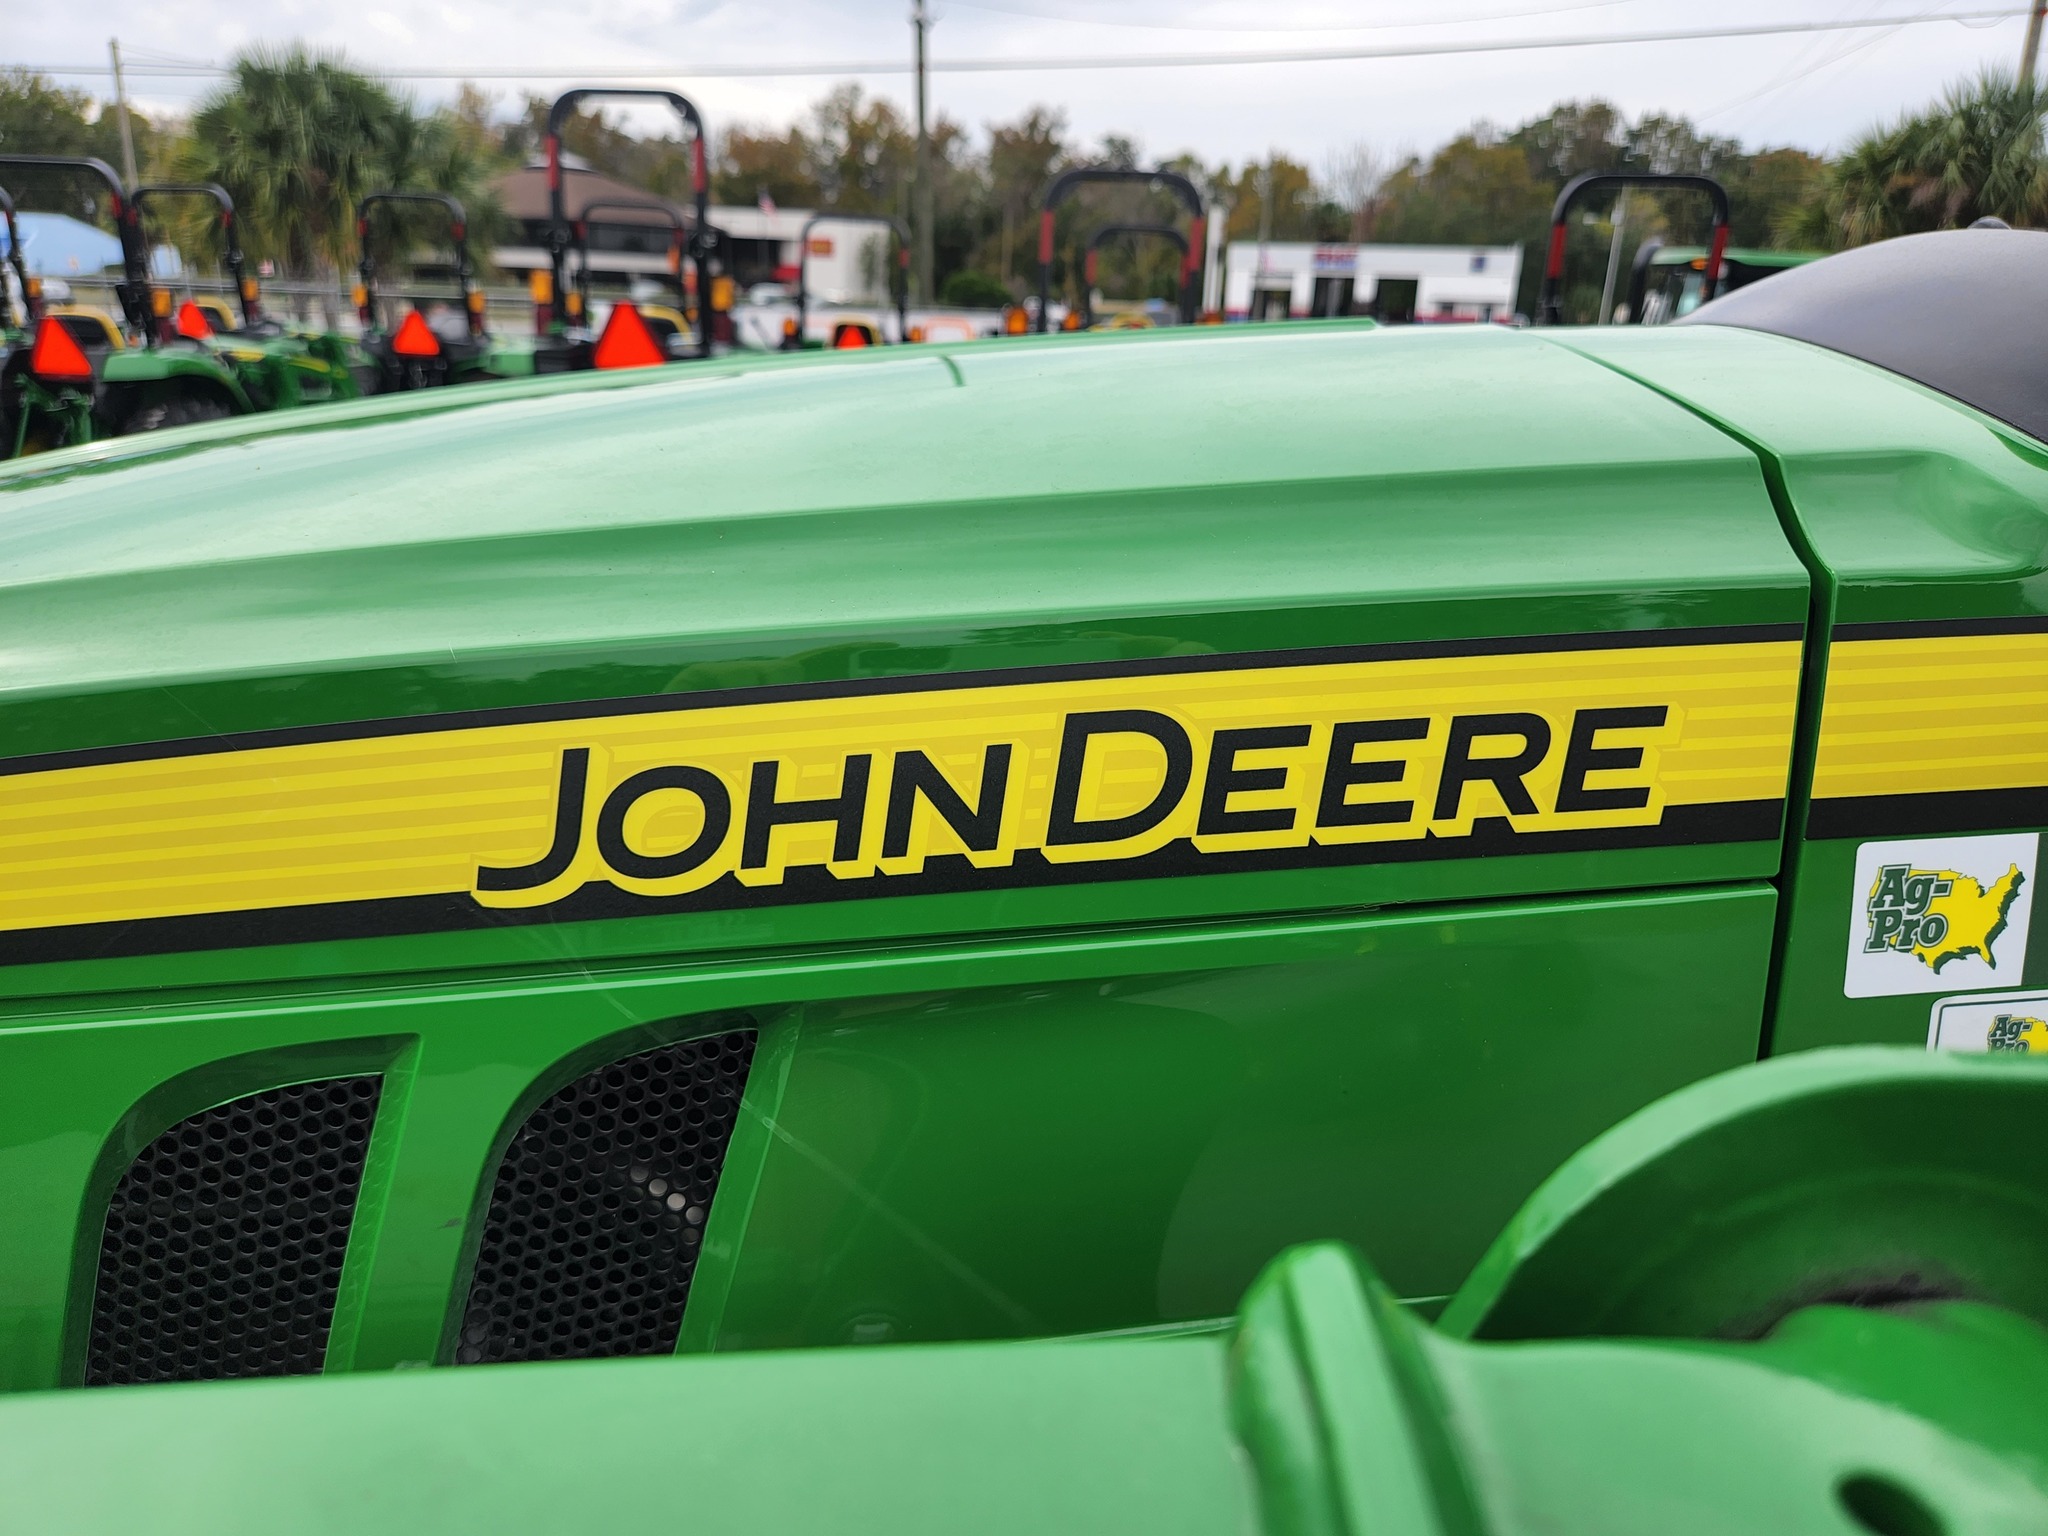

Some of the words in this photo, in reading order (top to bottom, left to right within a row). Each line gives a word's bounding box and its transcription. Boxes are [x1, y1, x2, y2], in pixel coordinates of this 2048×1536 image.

[475, 743, 1014, 893] JOHN
[1044, 705, 1670, 848] DEERE
[1869, 864, 1953, 915] Ag-
[1864, 910, 1948, 953] Pro
[1988, 1014, 2033, 1041] Ag-
